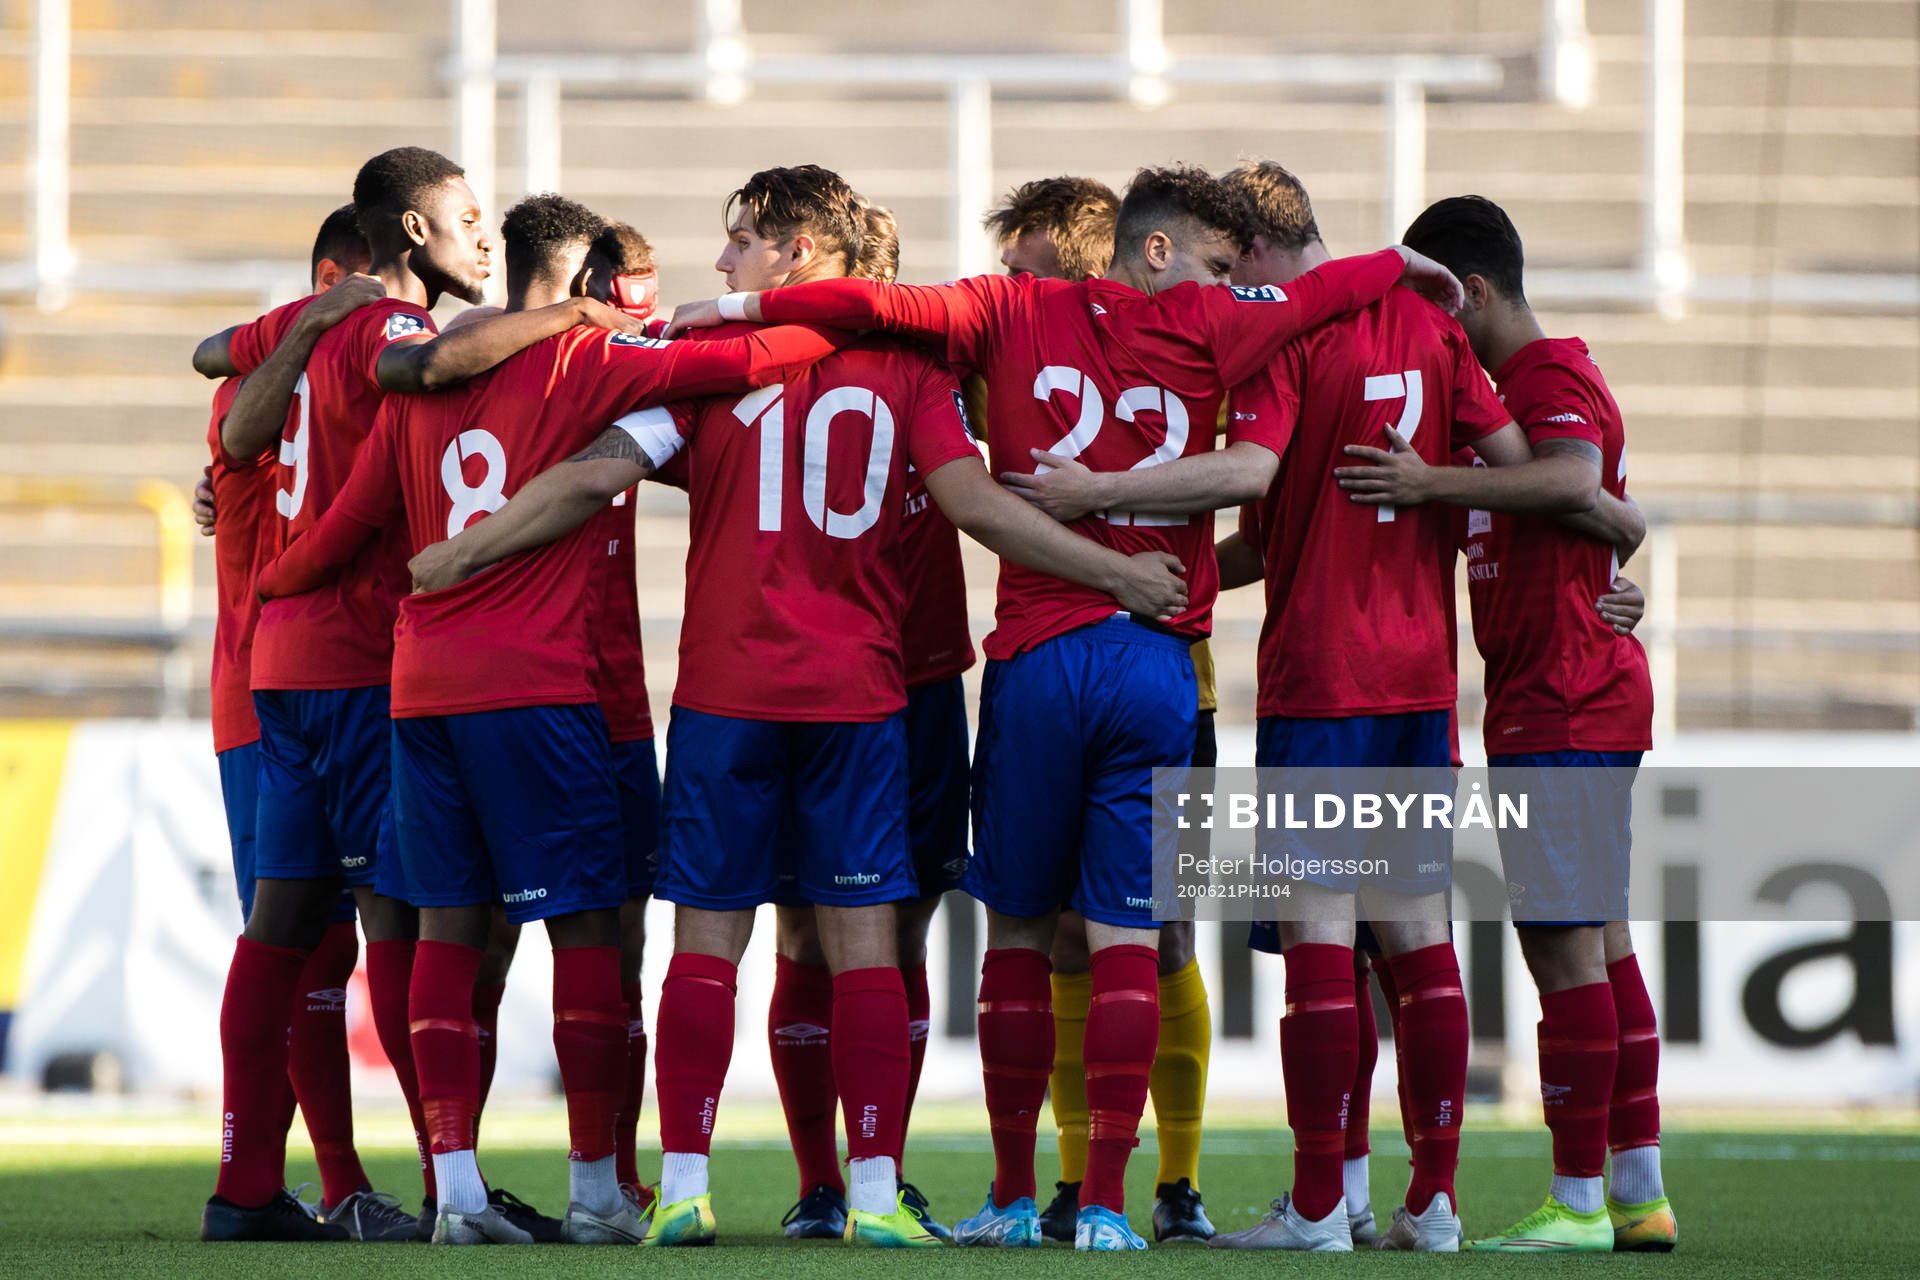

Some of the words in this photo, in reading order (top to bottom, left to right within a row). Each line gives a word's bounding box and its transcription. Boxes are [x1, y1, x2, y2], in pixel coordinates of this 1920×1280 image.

[731, 384, 895, 539] 10
[1033, 366, 1190, 527] 22
[1364, 370, 1423, 523] 7
[440, 429, 509, 540] 8
[503, 887, 548, 903] umbro
[834, 872, 881, 885] umbro
[1126, 896, 1162, 910] umbr
[221, 1112, 234, 1163] umbro
[699, 1097, 715, 1135] umbro
[859, 1105, 878, 1138] umbro
